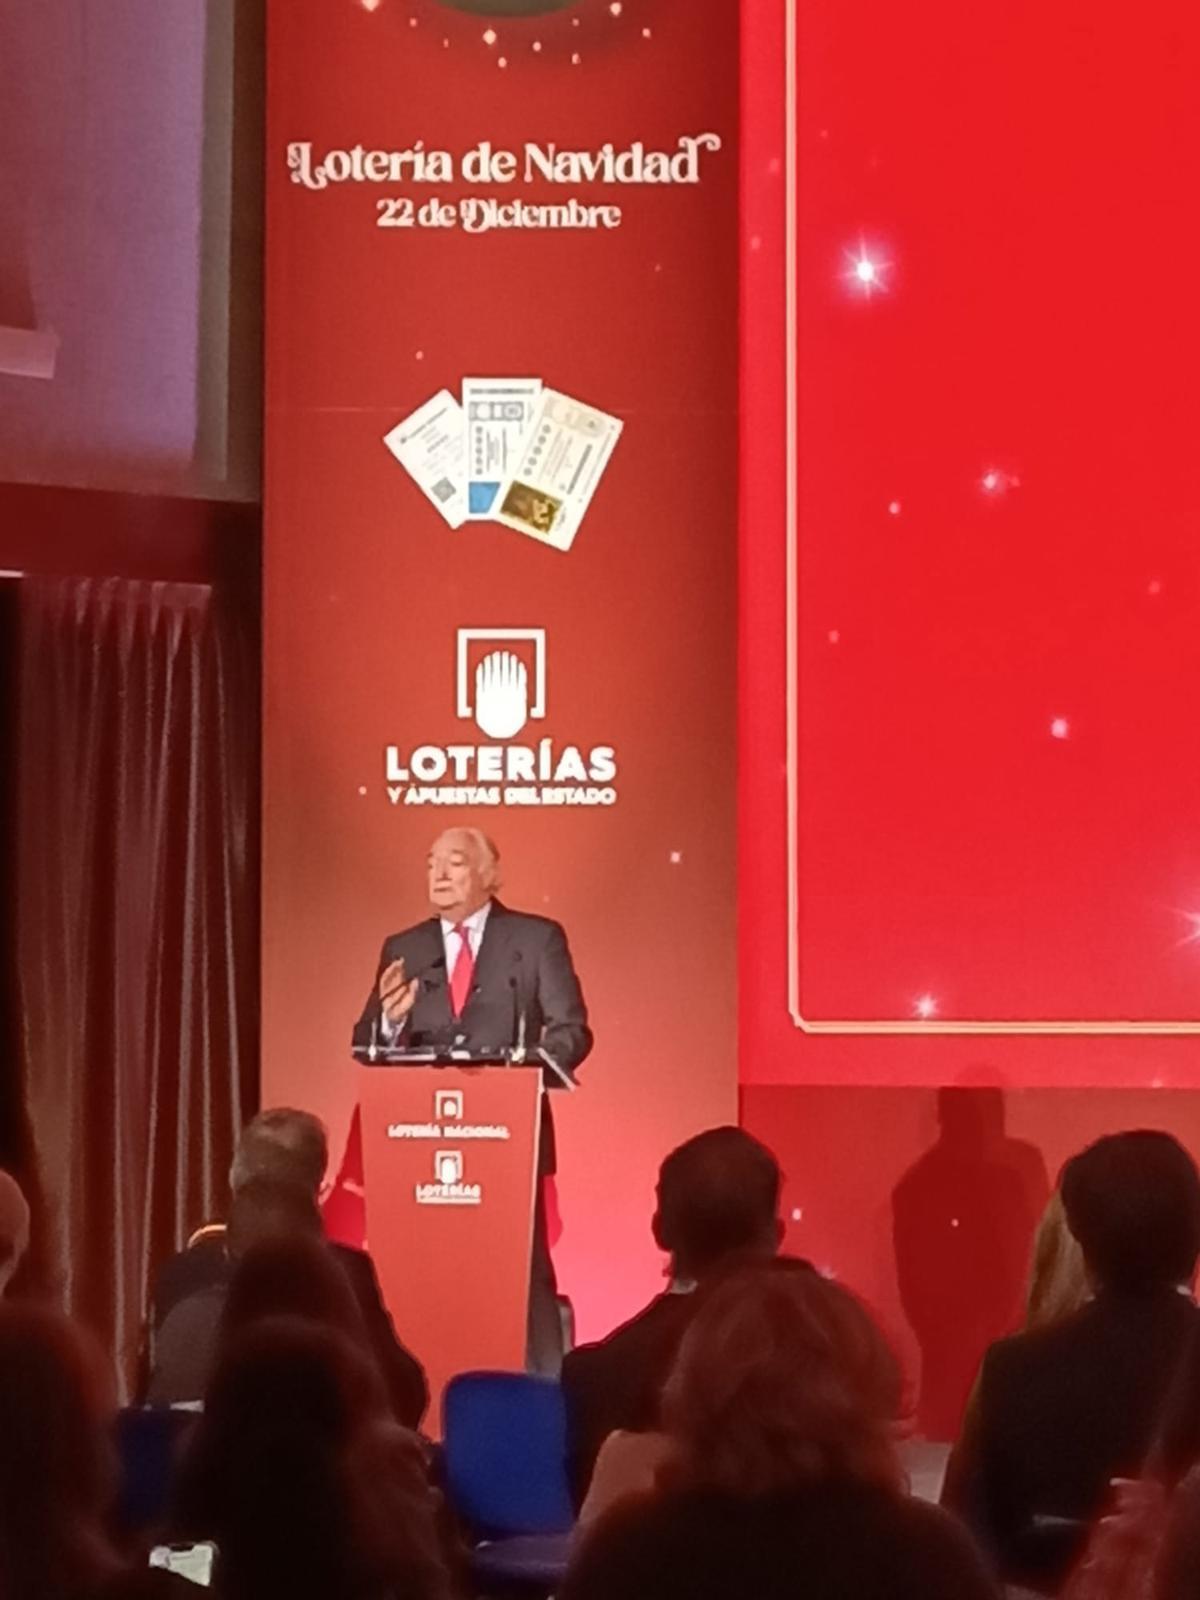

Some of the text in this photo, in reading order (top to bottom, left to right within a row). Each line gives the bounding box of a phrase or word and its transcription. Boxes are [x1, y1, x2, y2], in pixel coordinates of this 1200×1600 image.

[287, 133, 722, 190] Lotería de Navidad
[376, 198, 622, 234] 22 de Diciembre
[386, 738, 617, 782] LOTERÍAS
[386, 787, 403, 805] Y
[404, 786, 501, 805] APUESTAS
